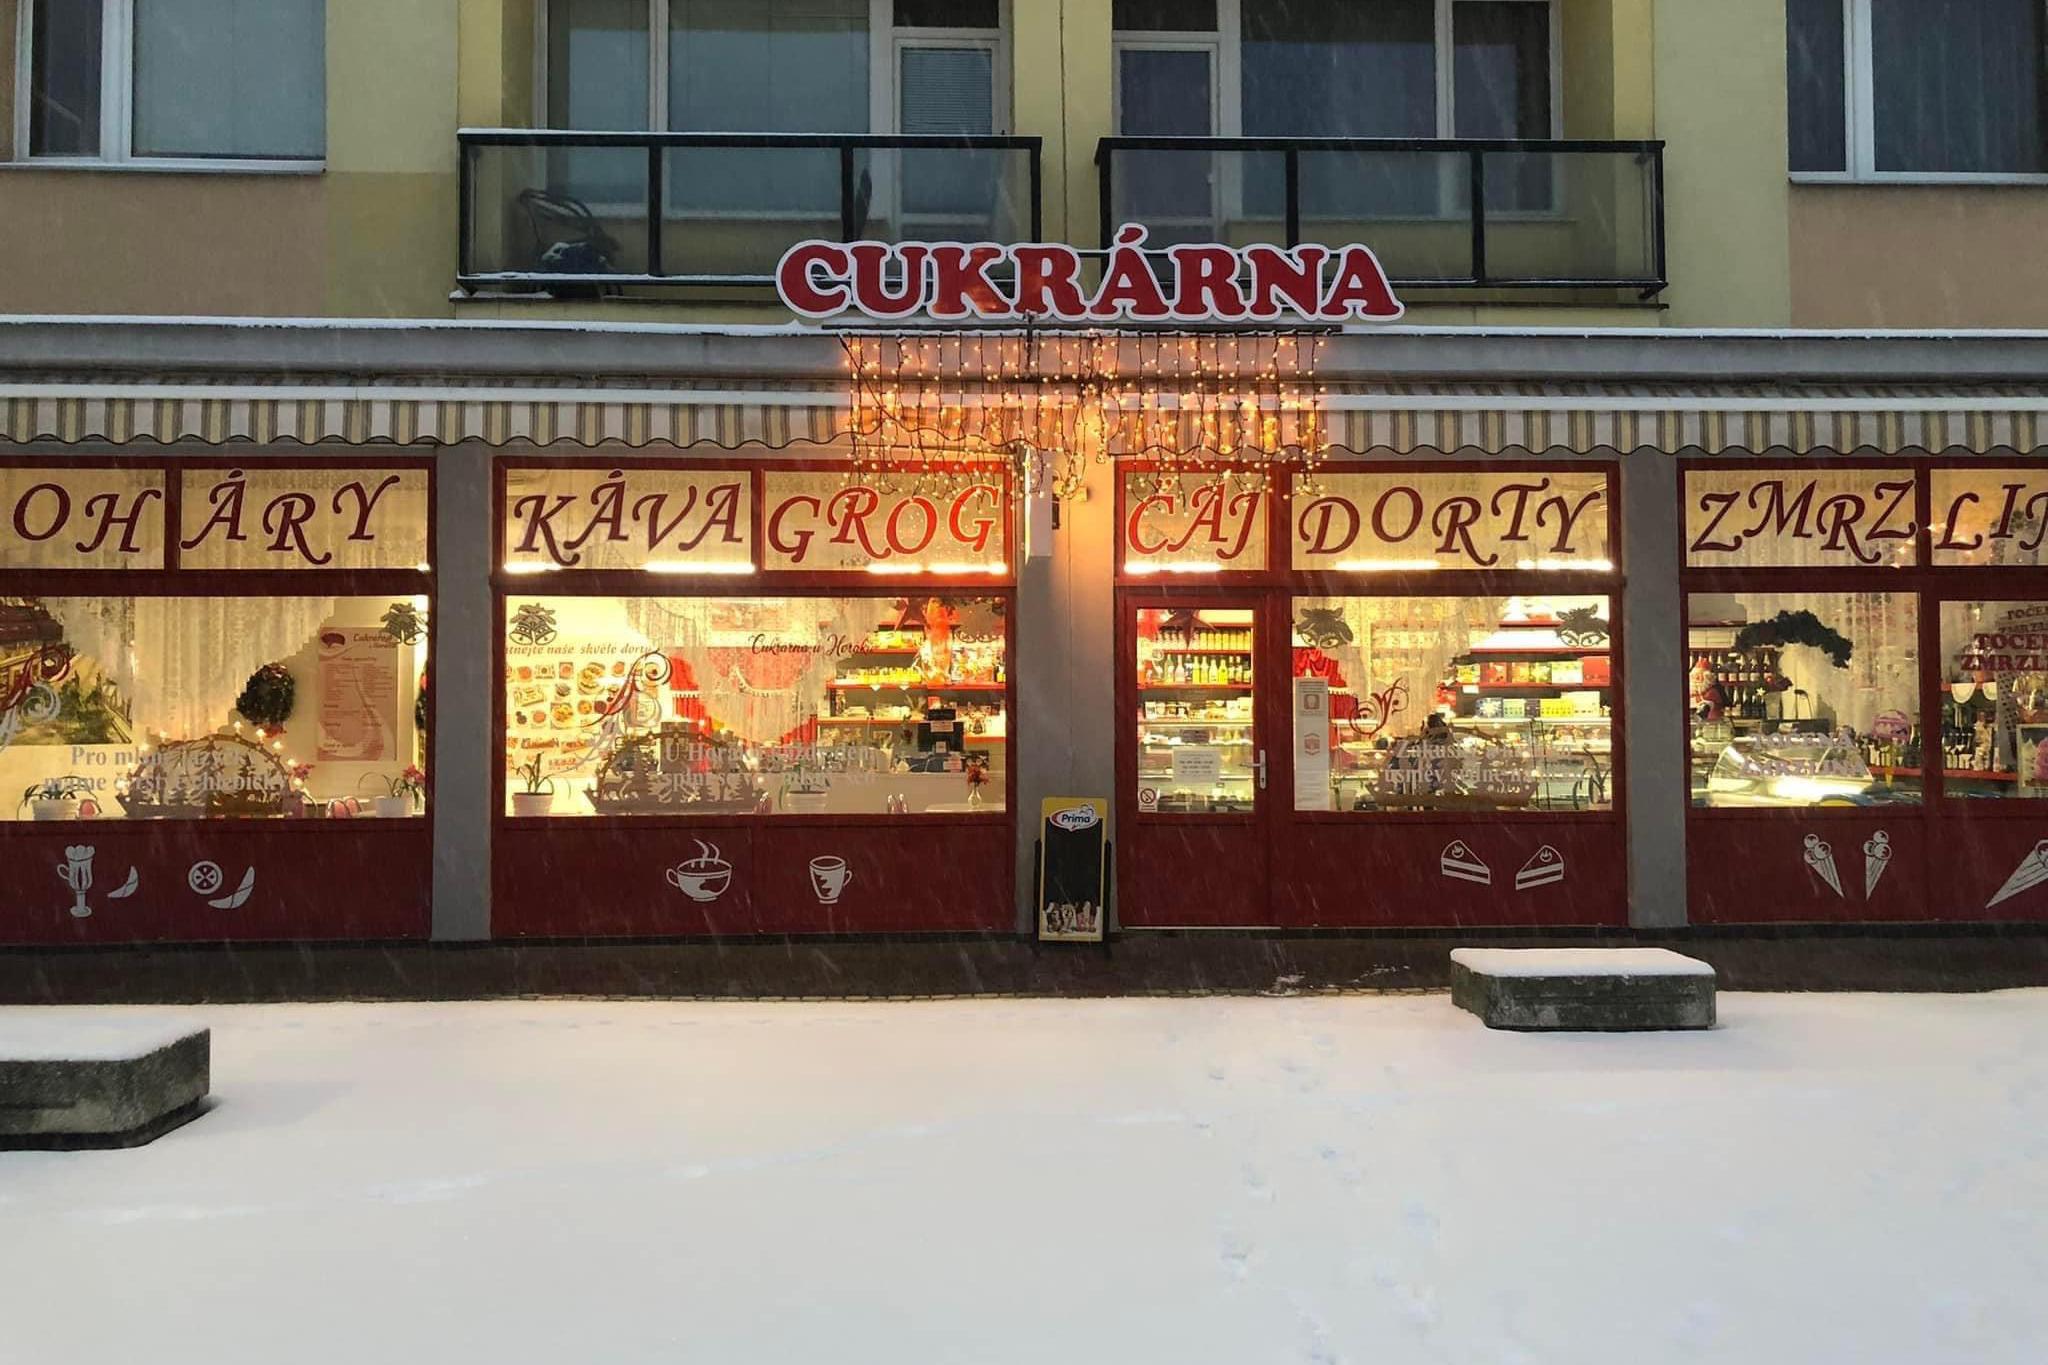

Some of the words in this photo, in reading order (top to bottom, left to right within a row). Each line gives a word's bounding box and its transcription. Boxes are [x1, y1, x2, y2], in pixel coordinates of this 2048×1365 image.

[775, 223, 1406, 321] CUKRÁRNA
[513, 470, 743, 567] KÁVA
[767, 484, 1000, 564] GROG
[1298, 477, 1601, 567] DORTY
[71, 746, 107, 766] Pro
[1061, 813, 1091, 823] Prima
